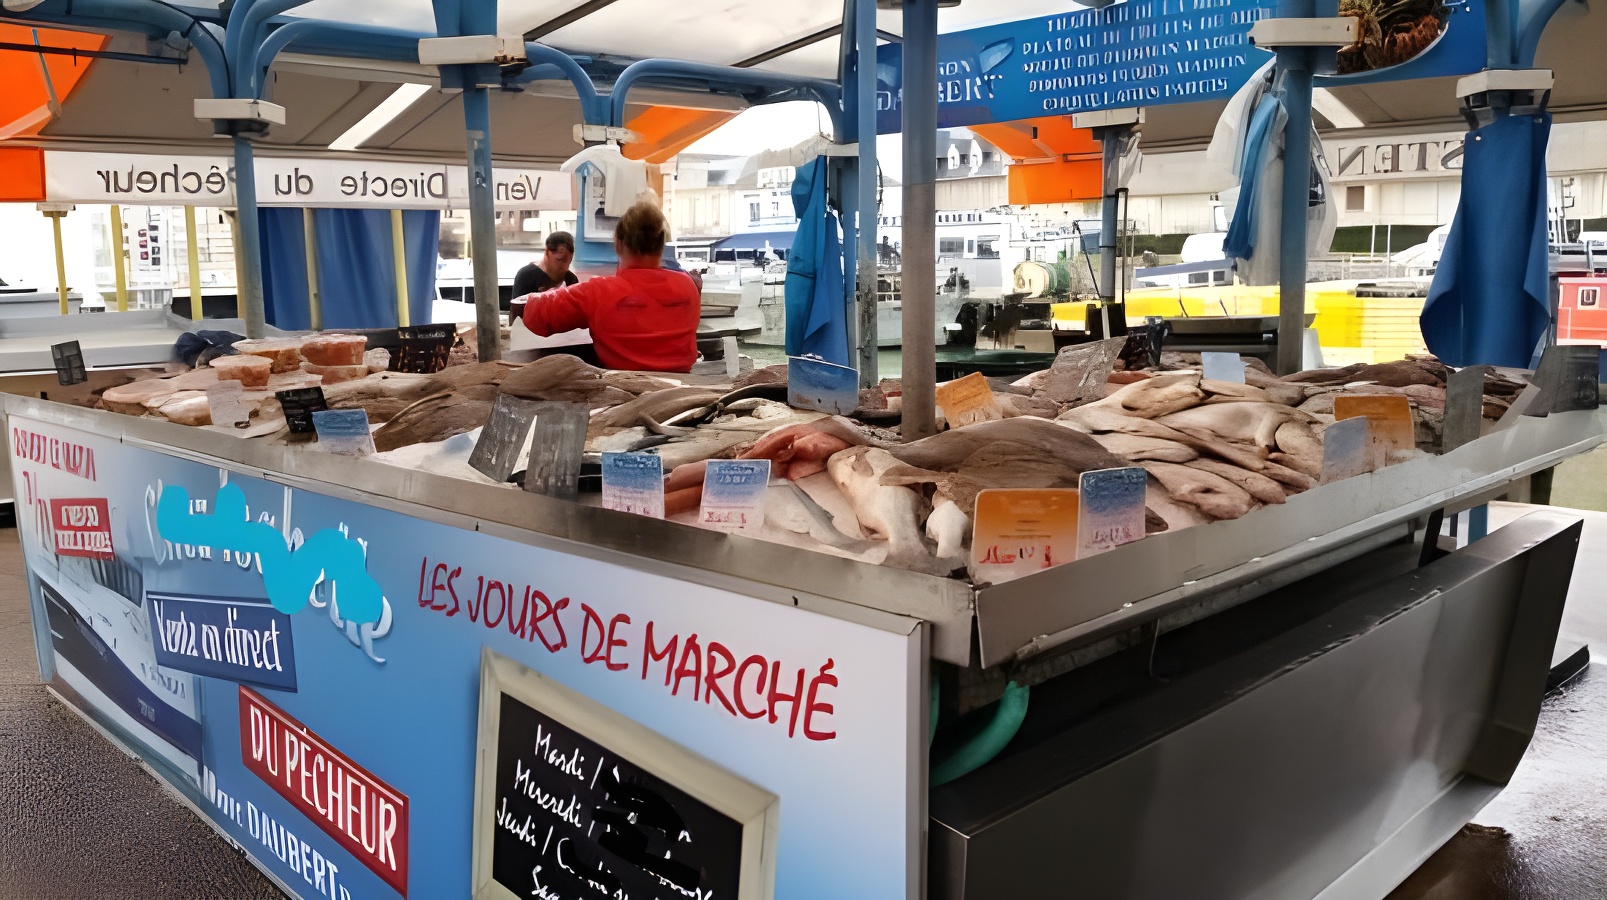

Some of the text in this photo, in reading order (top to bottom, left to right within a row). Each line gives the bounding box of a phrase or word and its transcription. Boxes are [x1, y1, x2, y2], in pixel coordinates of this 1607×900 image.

[418, 556, 839, 741] LES JOURS DE MARCHÉ
[249, 704, 278, 777] DU
[535, 724, 585, 781] Mardi
[514, 759, 582, 828] Mercredi
